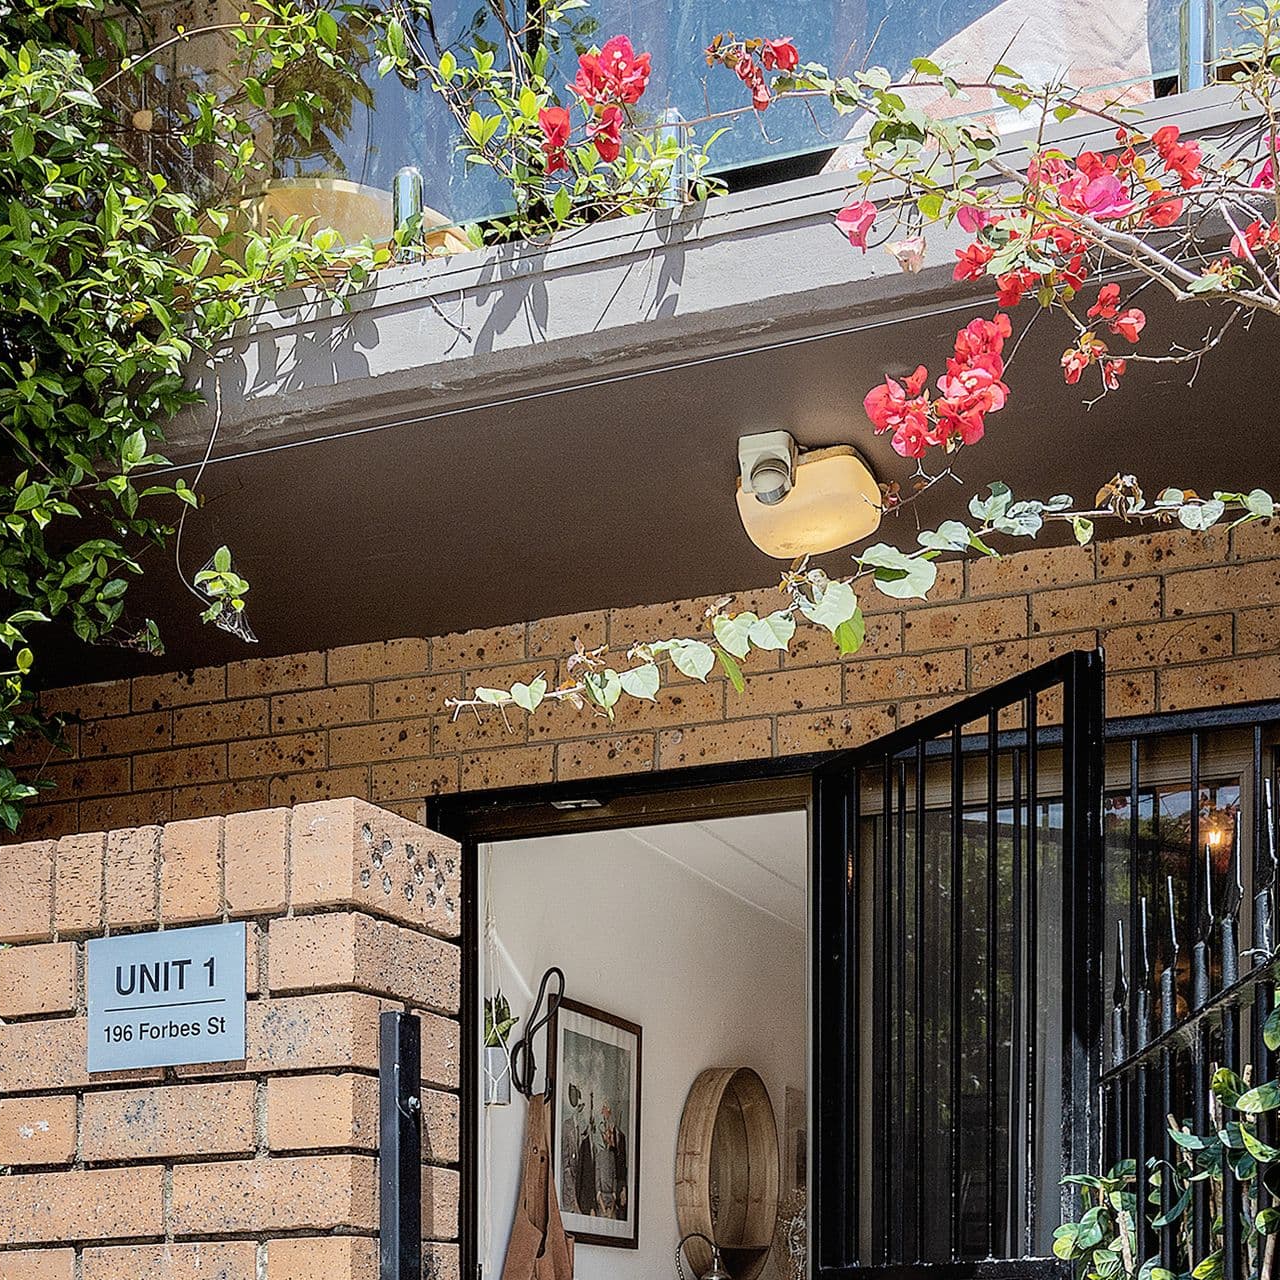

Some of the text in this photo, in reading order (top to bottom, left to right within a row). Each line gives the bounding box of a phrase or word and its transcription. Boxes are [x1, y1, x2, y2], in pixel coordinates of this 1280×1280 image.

[116, 957, 215, 995] UNIT 1
[104, 1016, 226, 1043] 196 Forbes St
